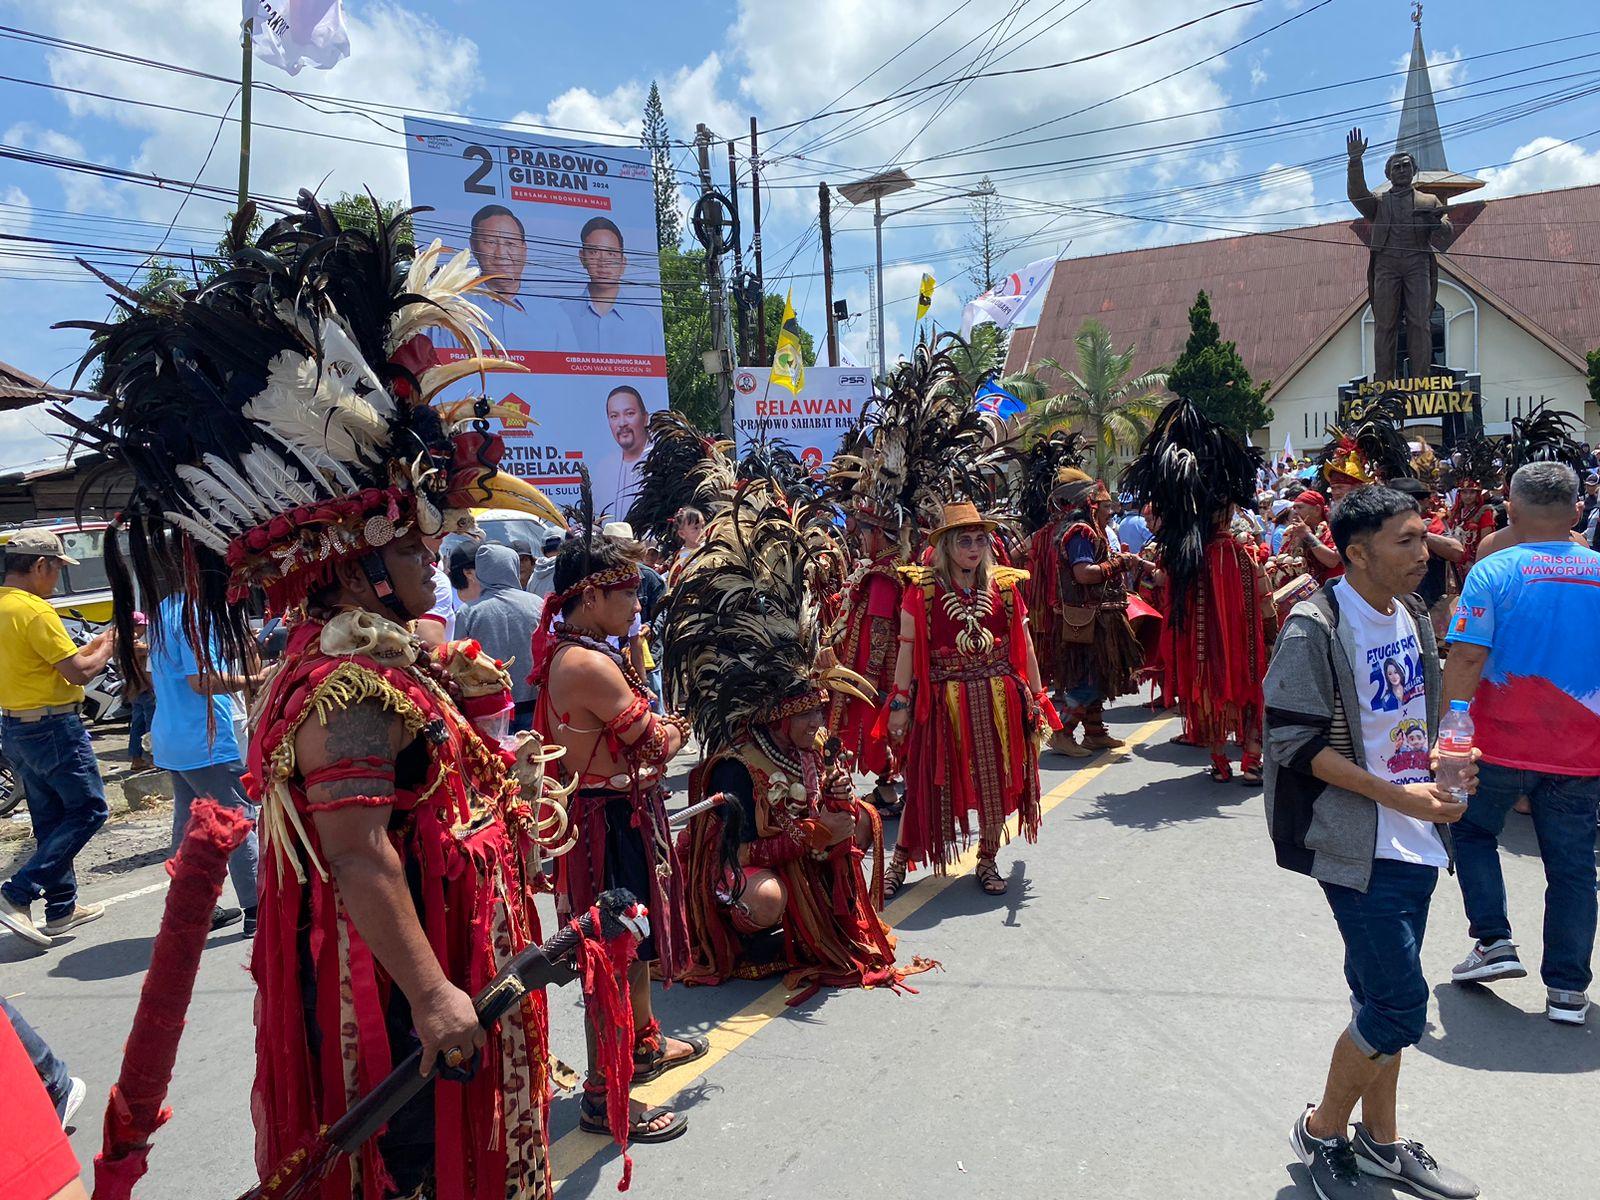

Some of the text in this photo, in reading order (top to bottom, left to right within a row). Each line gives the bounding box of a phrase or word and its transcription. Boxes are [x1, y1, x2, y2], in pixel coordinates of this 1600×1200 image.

[507, 146, 608, 176] PRABOWO
[463, 145, 496, 195] 2
[508, 166, 609, 191] GIBRAN 2024
[514, 190, 548, 199] BERSAMA
[549, 194, 588, 203] INDONESIA
[592, 357, 632, 365] RAKABUMING
[841, 376, 865, 384] PSR
[1359, 376, 1453, 396] MONUMEN
[755, 398, 851, 416] RELAWAN
[741, 418, 789, 431] PRAOWO
[791, 416, 832, 429] SAHABAT
[502, 446, 562, 460] RTIN D.
[498, 461, 582, 476] MBELAKA
[539, 487, 580, 496] PIL SULU
[1532, 555, 1598, 565] PRISCILIA
